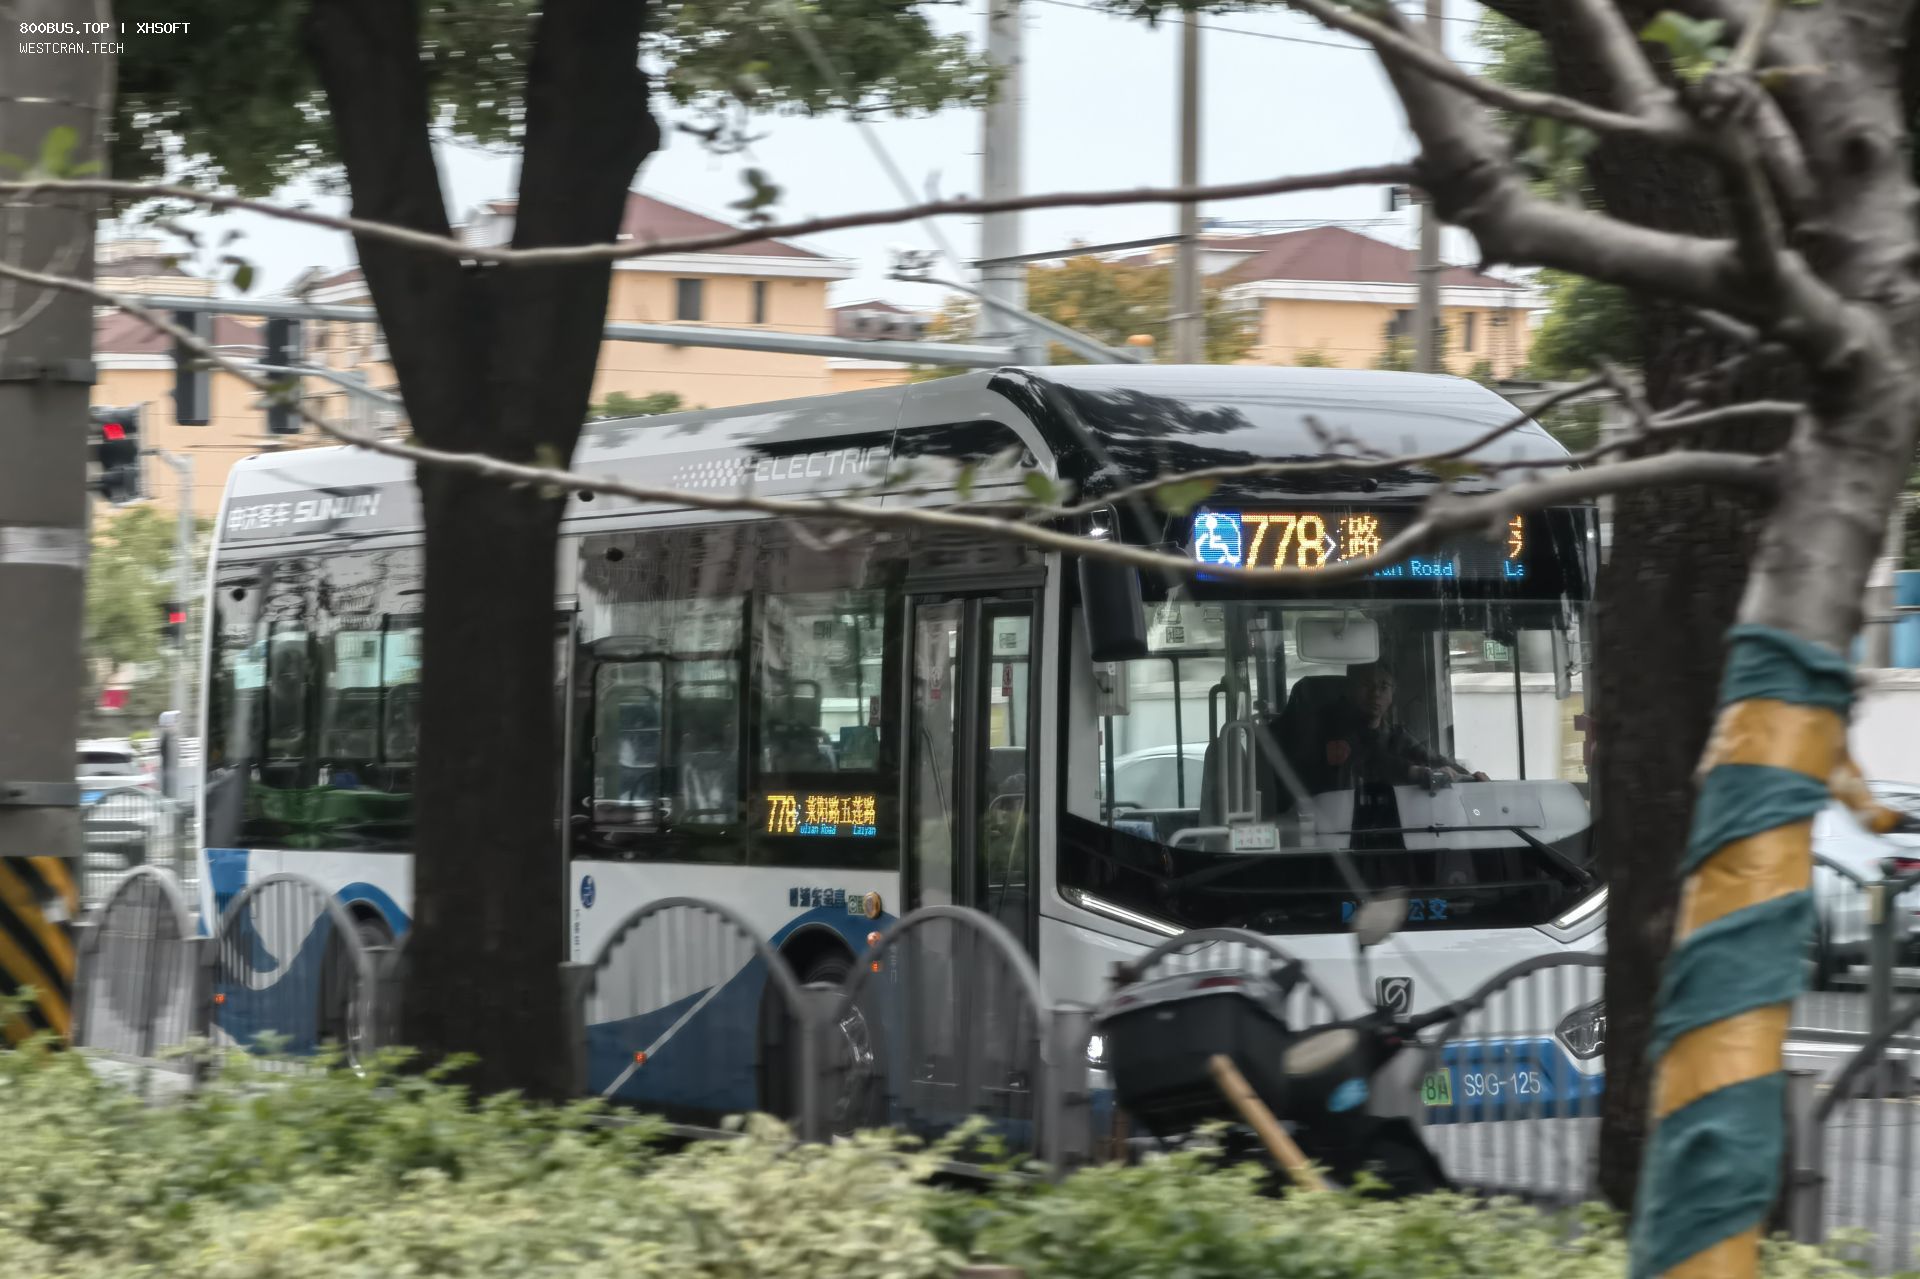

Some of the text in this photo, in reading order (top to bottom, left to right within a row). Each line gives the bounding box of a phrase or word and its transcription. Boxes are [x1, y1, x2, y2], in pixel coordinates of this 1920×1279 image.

[1241, 513, 1383, 570] 778 路
[1410, 560, 1453, 577] Road
[766, 795, 796, 833] 778
[1464, 1071, 1541, 1098] S9G-125
